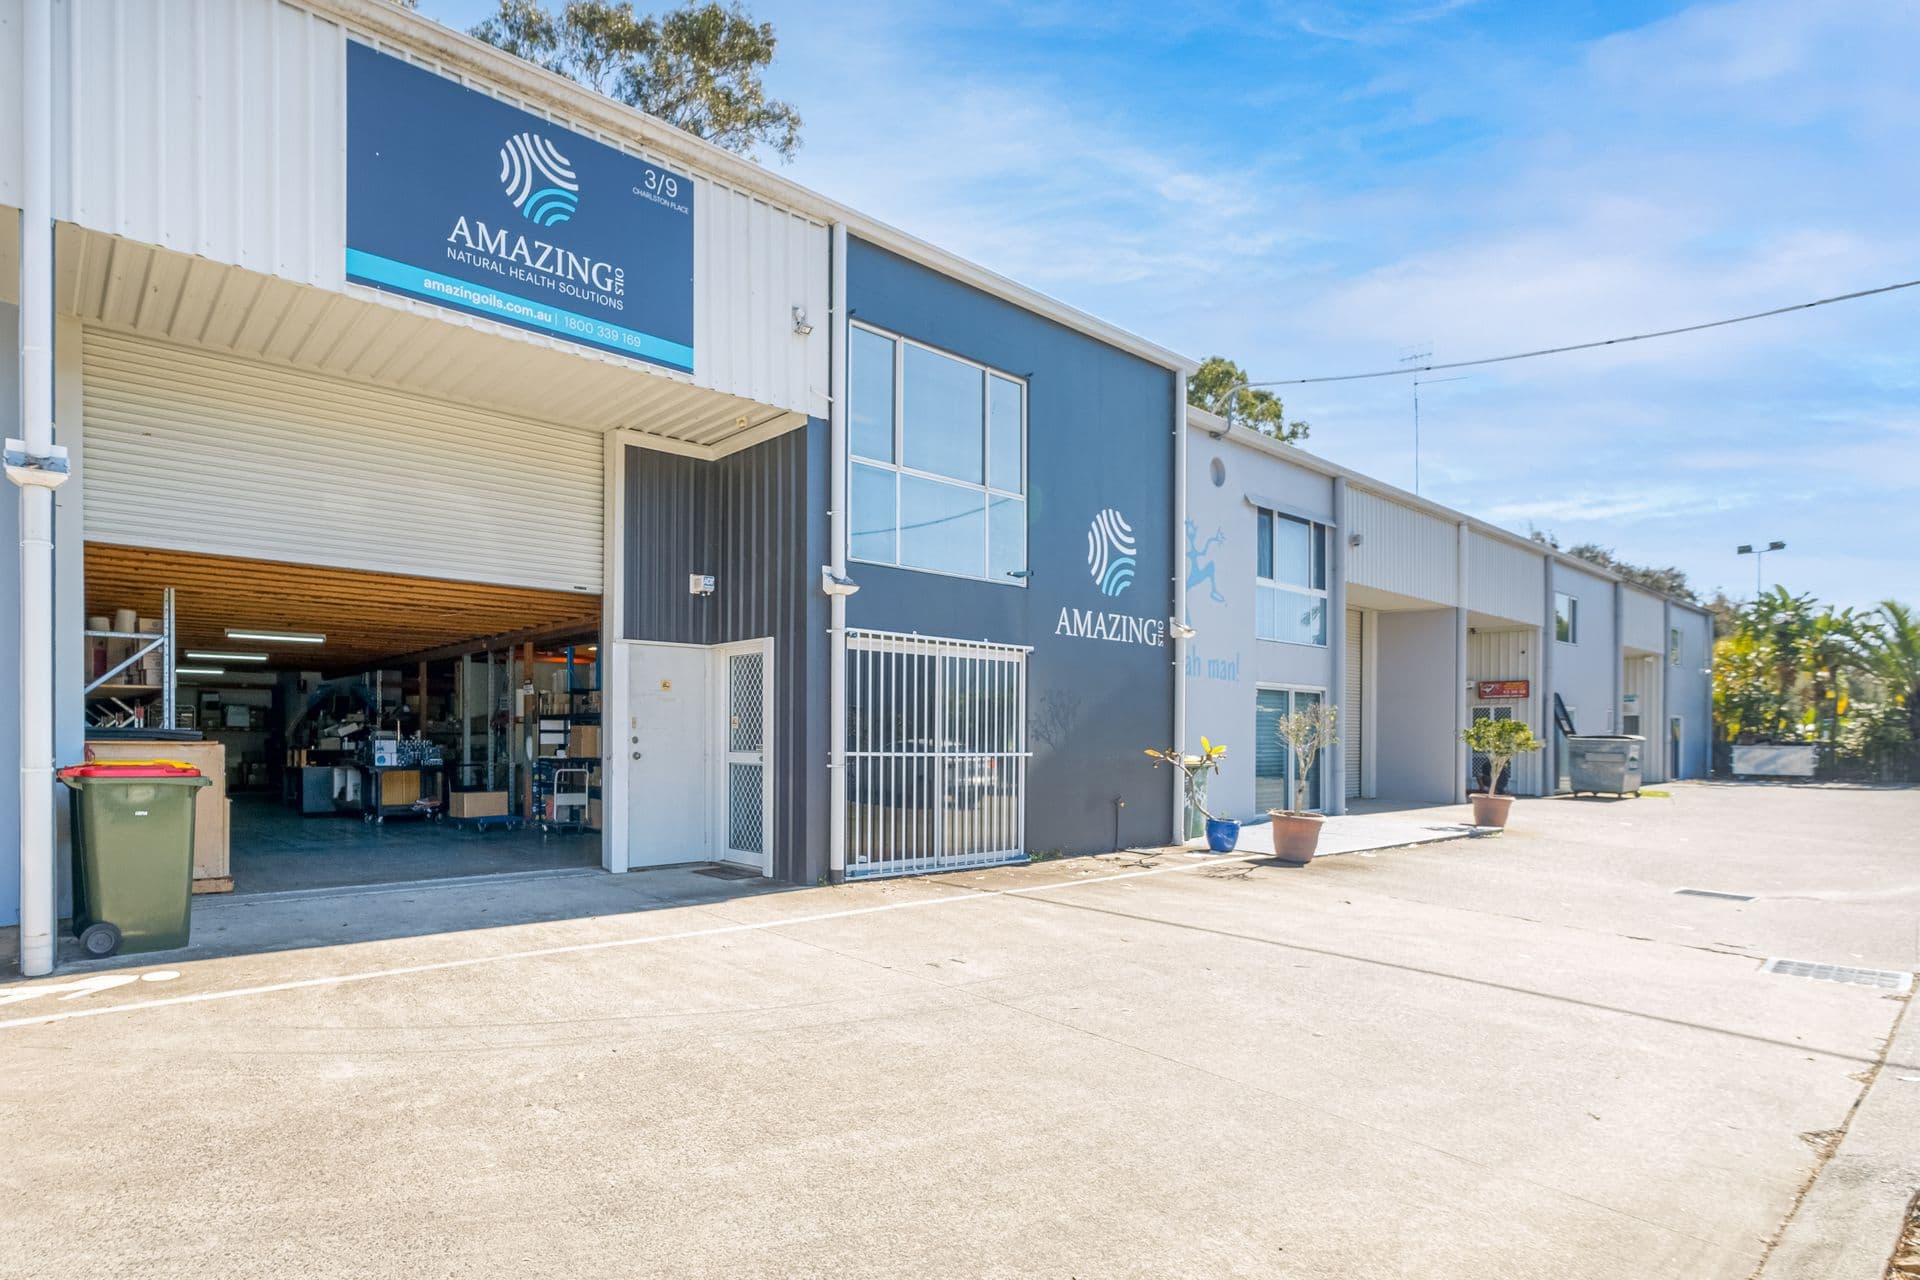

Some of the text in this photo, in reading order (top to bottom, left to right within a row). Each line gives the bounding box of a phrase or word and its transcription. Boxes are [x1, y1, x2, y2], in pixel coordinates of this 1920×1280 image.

[645, 169, 678, 198] 3/9
[670, 201, 689, 215] PLACE
[447, 215, 614, 292] AMAZING
[447, 247, 624, 311] NATURAL HEALTH SOLUTIONS
[614, 267, 625, 296] OILS
[423, 278, 641, 348] amazingoils.com.au 1800 339 169
[1054, 606, 1158, 646] AMAZING
[1157, 620, 1165, 647] OILS
[1185, 645, 1241, 682] ah man!
